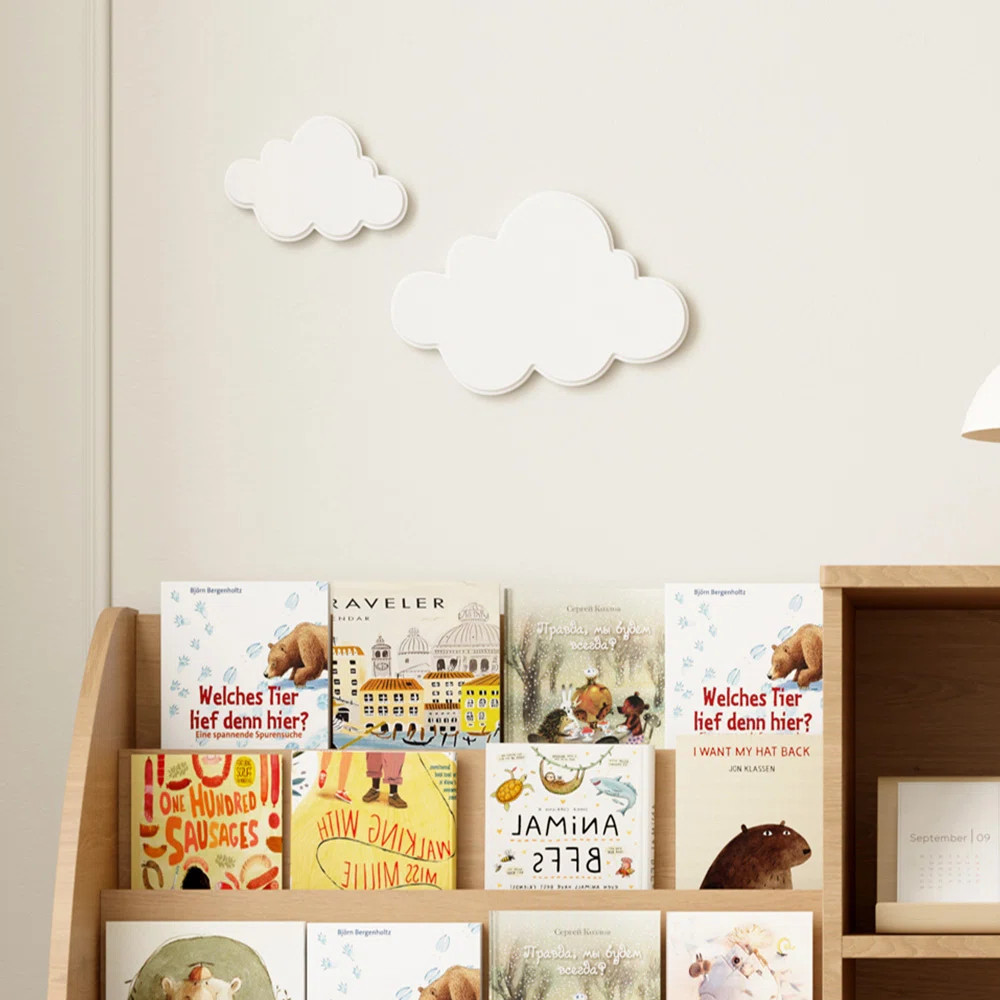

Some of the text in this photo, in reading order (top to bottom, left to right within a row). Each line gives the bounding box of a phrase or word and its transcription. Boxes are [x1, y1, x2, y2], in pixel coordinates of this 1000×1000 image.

[199, 685, 299, 705] Welches Tier
[703, 686, 802, 707] Welches Tier
[190, 709, 309, 731] lief denn hier?
[694, 711, 812, 733] lief denn hier?
[195, 731, 302, 740] Eine spannende Spurensuche
[693, 746, 810, 757] I WANT MY HAT BACK
[729, 765, 775, 773] JON KLASSEN
[909, 833, 991, 845] September 09
